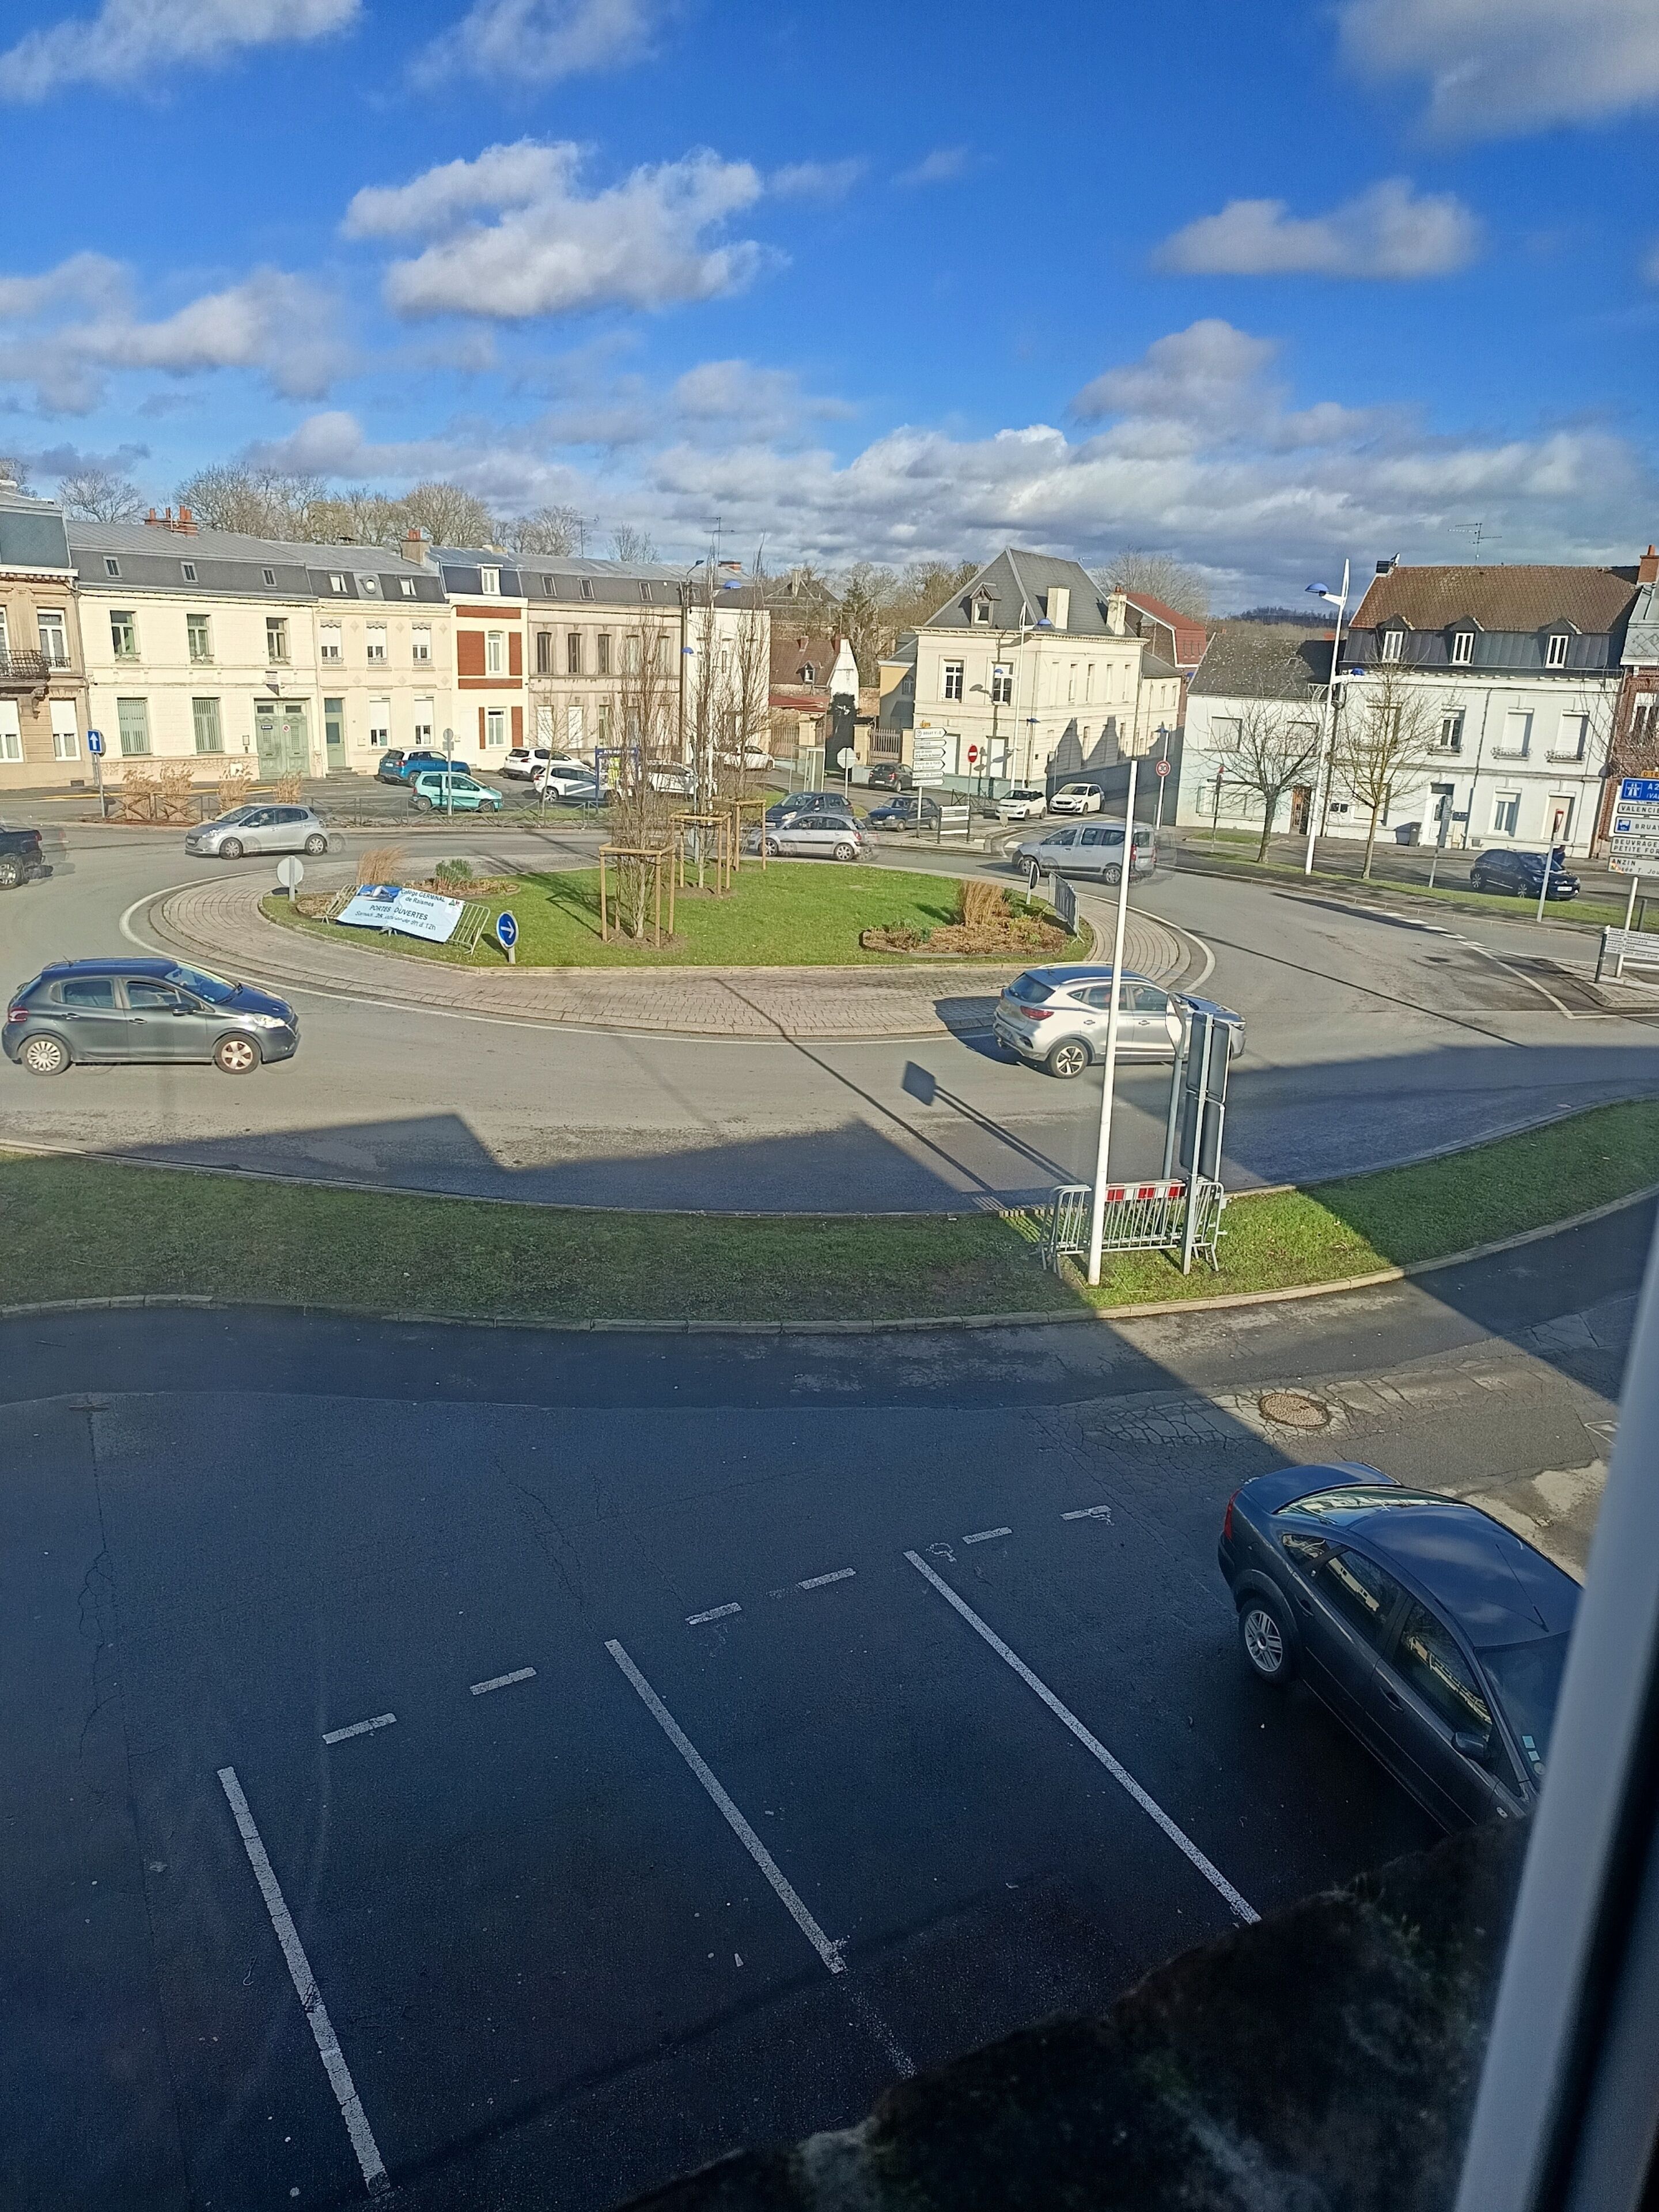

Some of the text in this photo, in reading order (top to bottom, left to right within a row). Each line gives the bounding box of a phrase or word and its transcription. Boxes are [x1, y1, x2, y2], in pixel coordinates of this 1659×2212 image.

[1614, 839, 1659, 848] BEUVRAGE
[419, 892, 445, 903] GERMINAL
[412, 898, 434, 907] Raismes
[394, 907, 429, 921] OUVERTES
[426, 923, 436, 931] 12h
